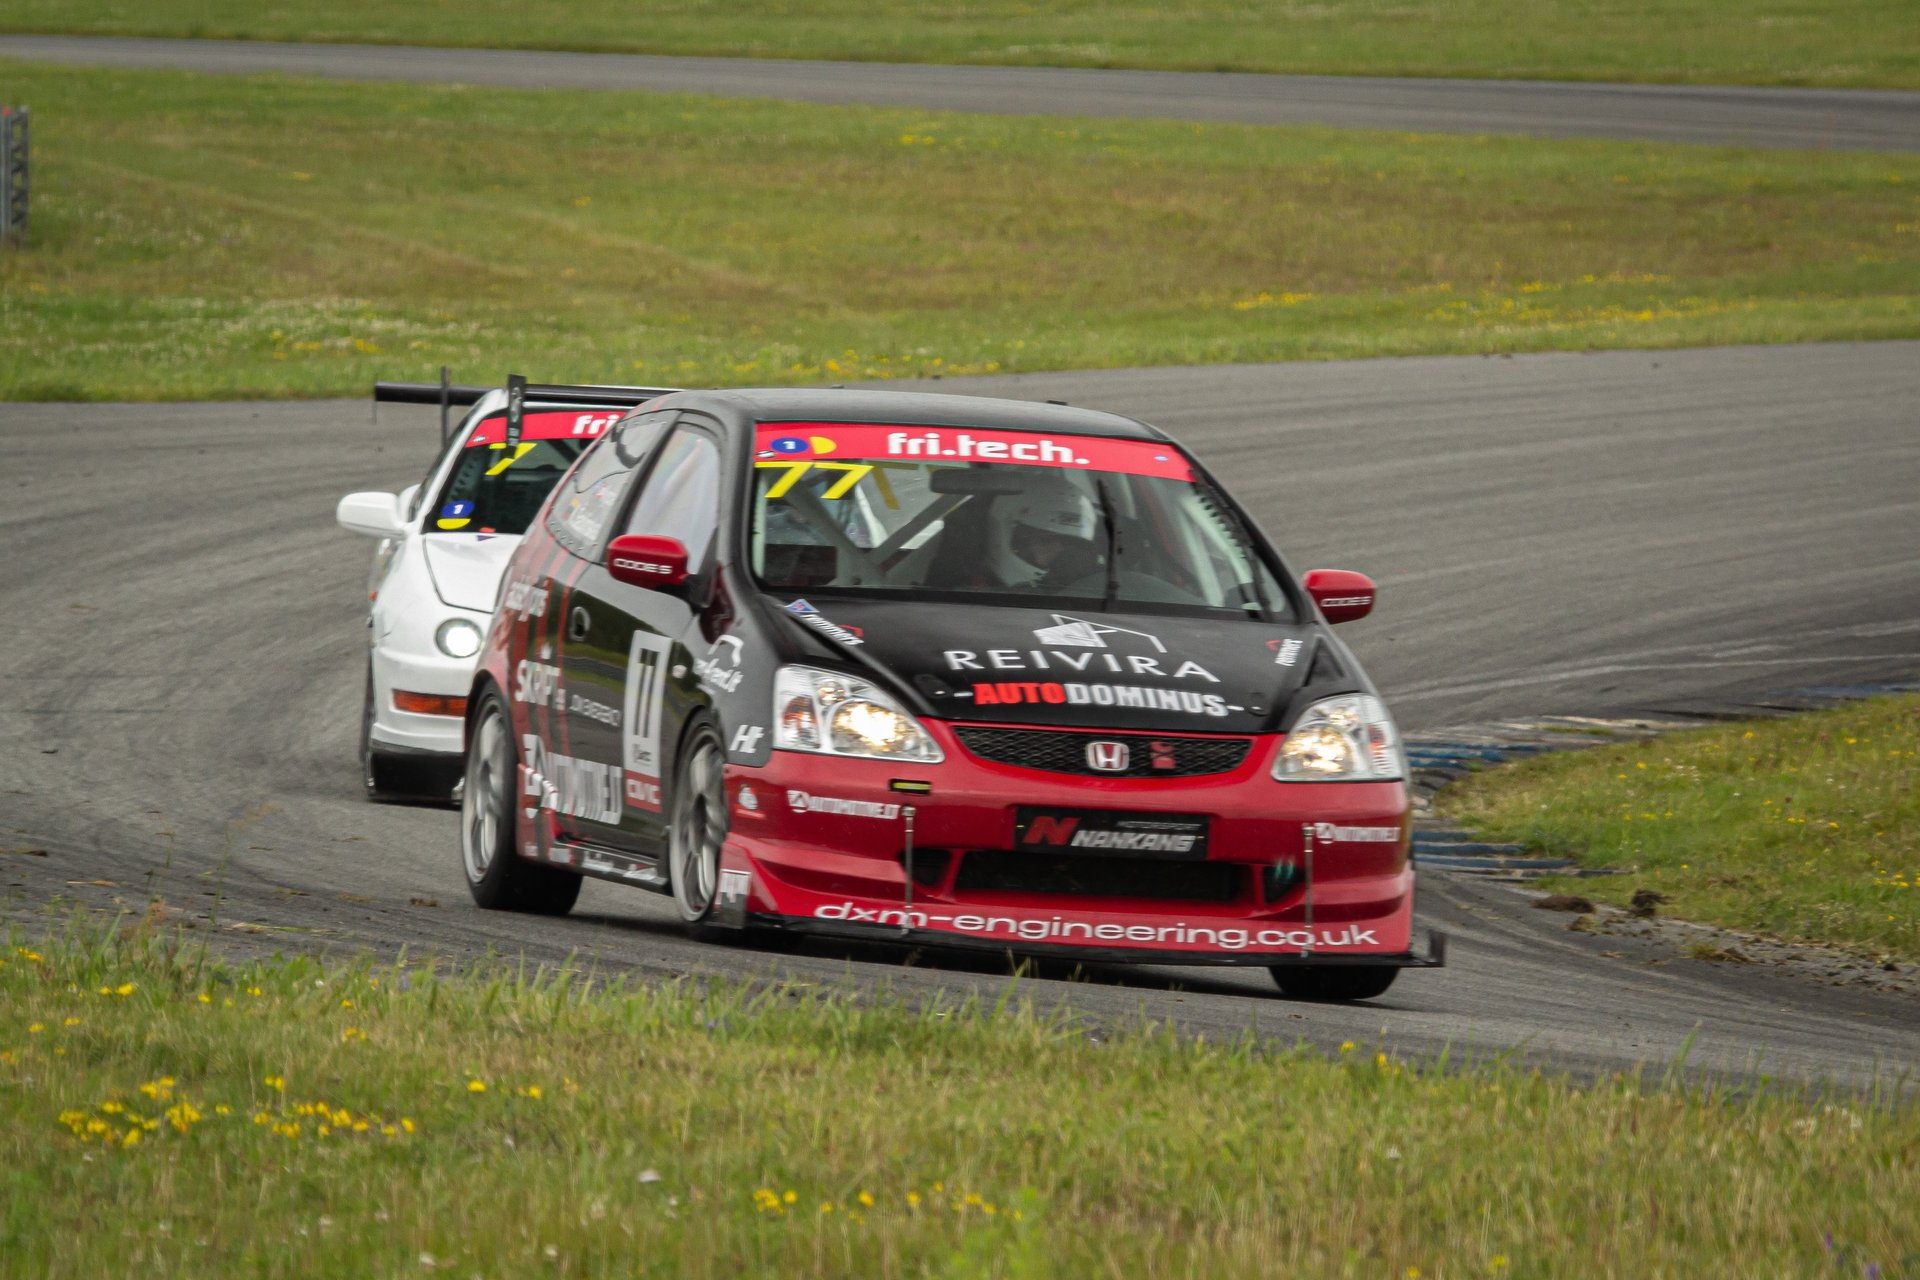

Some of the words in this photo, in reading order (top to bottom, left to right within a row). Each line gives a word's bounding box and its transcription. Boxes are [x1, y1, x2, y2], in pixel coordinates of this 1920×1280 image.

[887, 432, 1091, 465] fri.tech.
[755, 461, 875, 500] 77
[453, 503, 464, 515] 1
[943, 649, 1222, 683] REIVIRA
[813, 901, 1380, 950] dxm-engineering.co.uk
